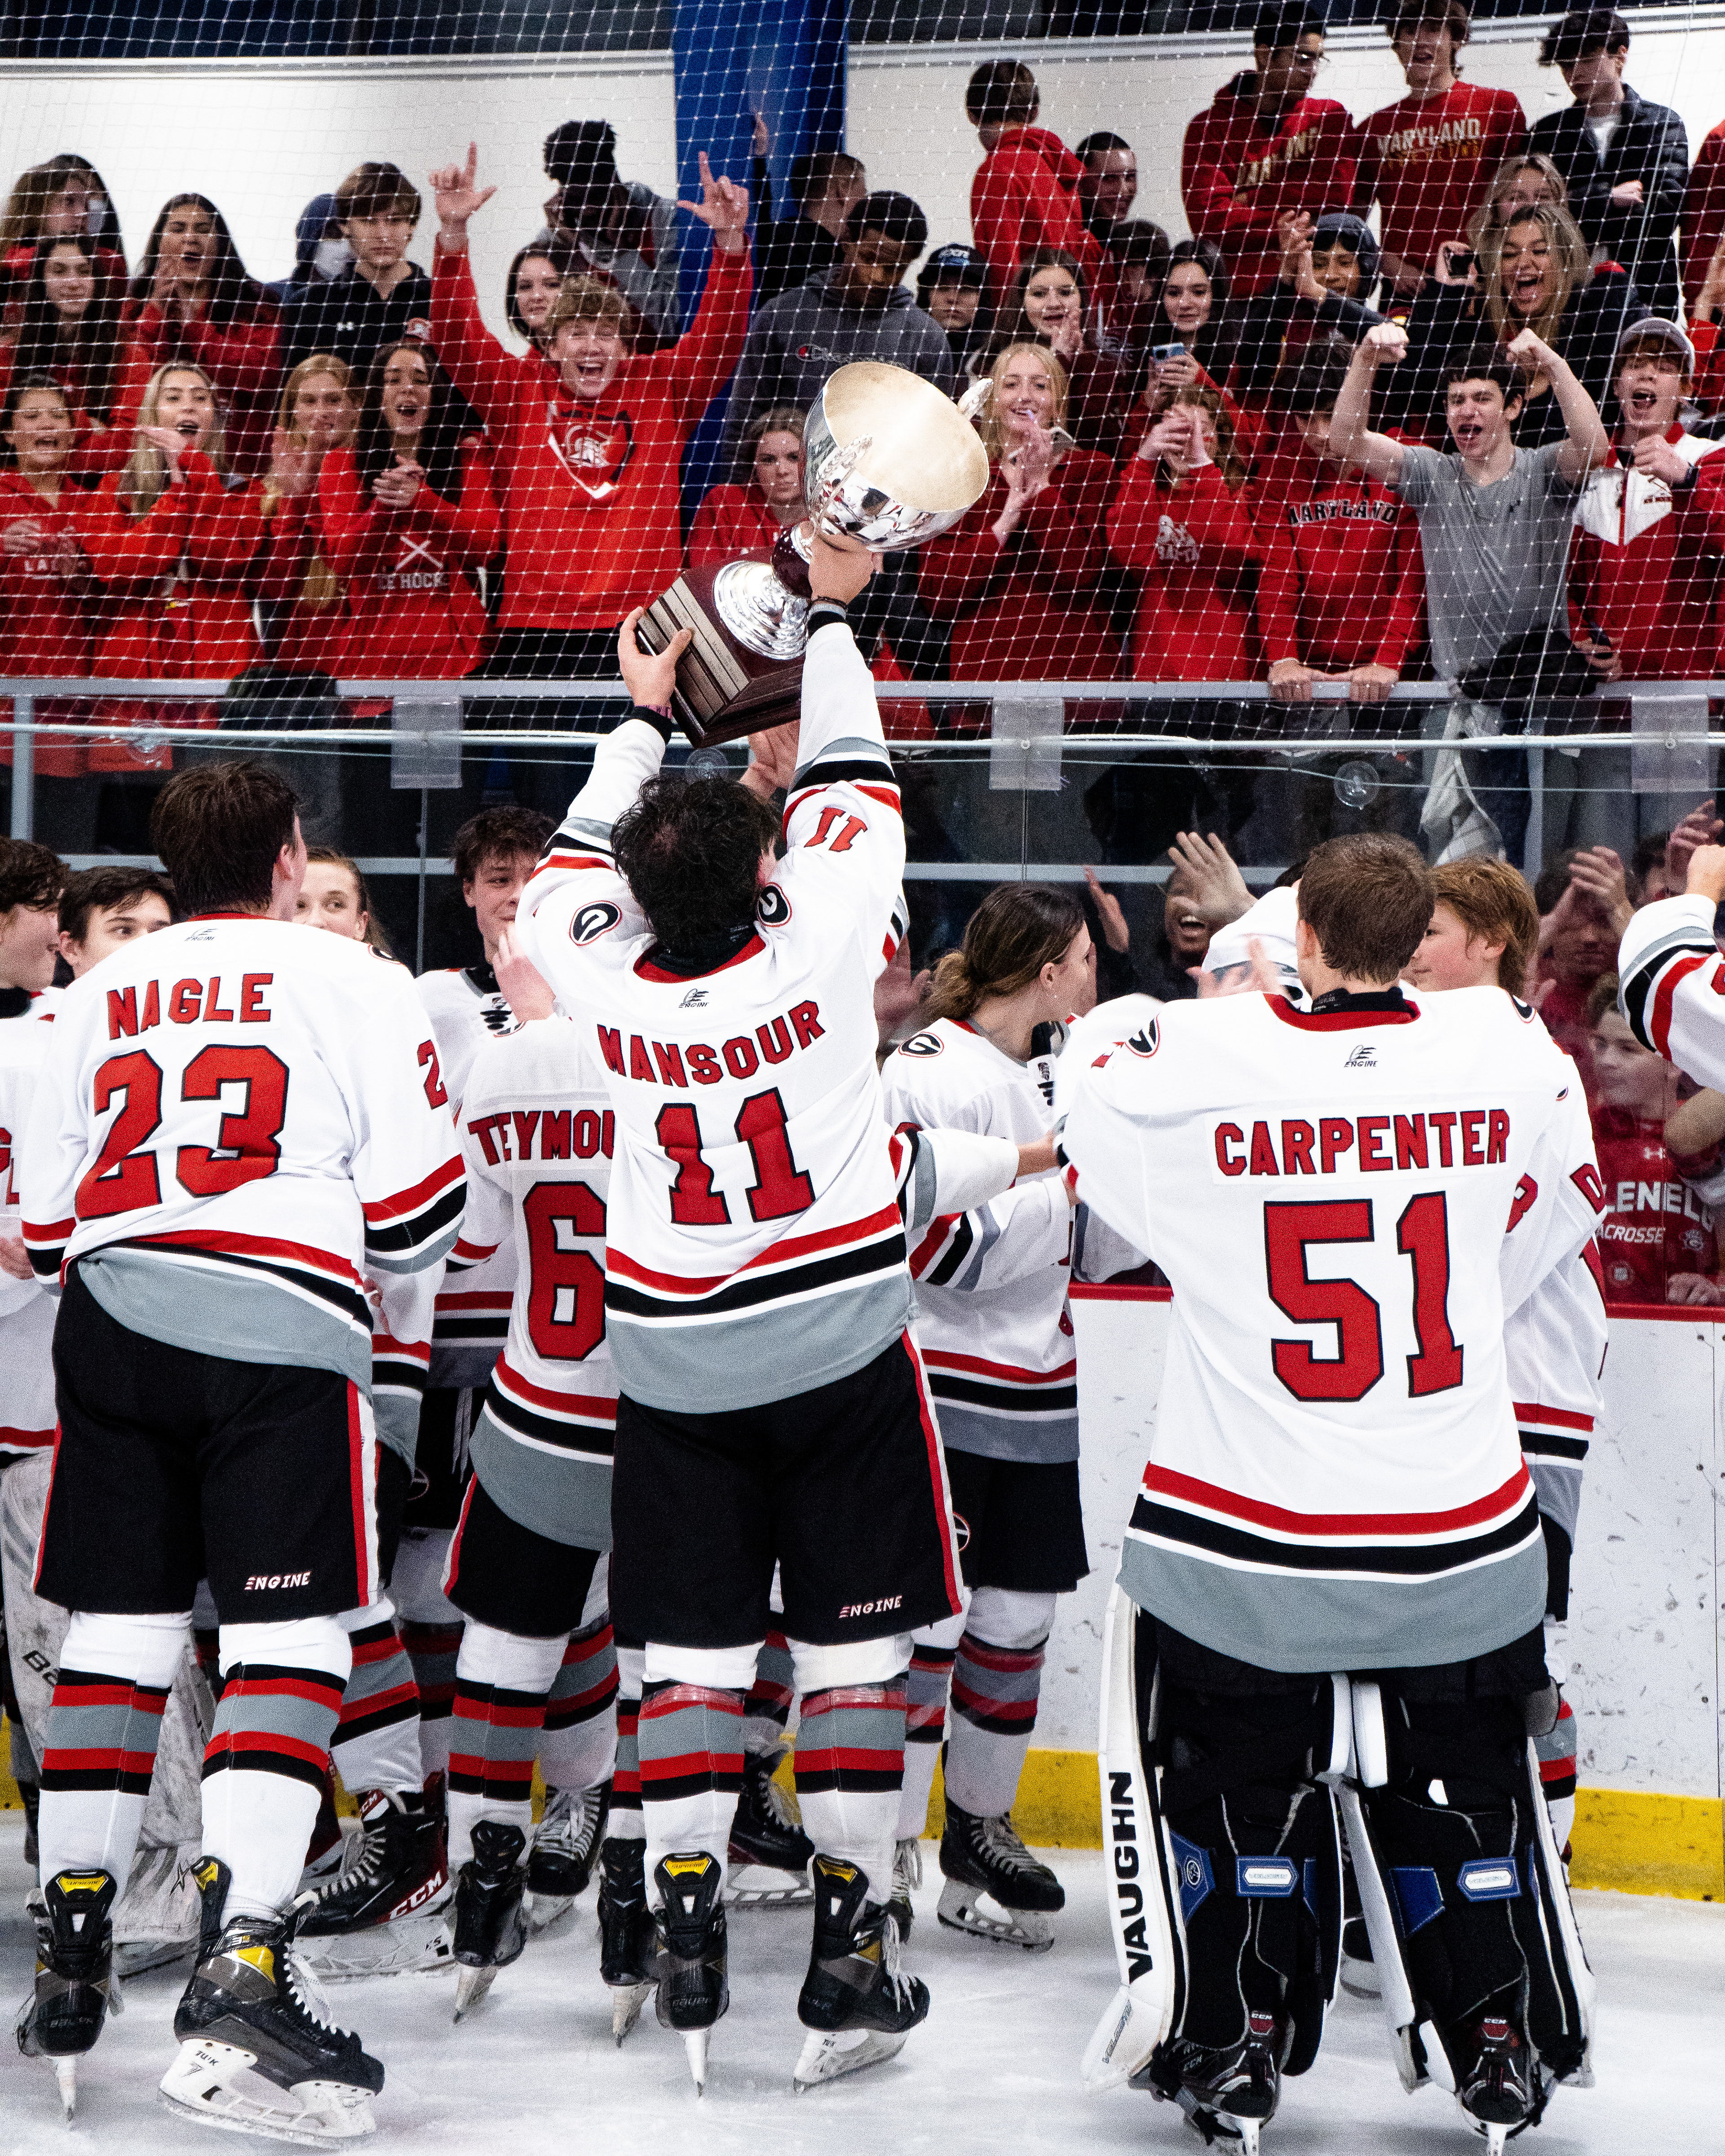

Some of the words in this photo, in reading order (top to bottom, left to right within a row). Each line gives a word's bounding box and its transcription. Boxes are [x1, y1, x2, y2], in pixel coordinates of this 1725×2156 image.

[107, 973, 273, 1040] NAGLE
[597, 1000, 826, 1088] MANSOUR
[75, 1044, 289, 1222] 23
[655, 1087, 816, 1226] 11
[1215, 1109, 1510, 1176] CARPENTER
[523, 1182, 606, 1361] 6
[1597, 1224, 1665, 1244] ACROSSE
[1263, 1191, 1464, 1402] 51
[244, 1572, 311, 1591] ENGINE
[839, 1595, 902, 1618] ENGINE
[389, 1872, 442, 1921] CCM
[1108, 1772, 1153, 1983] VAUGHN
